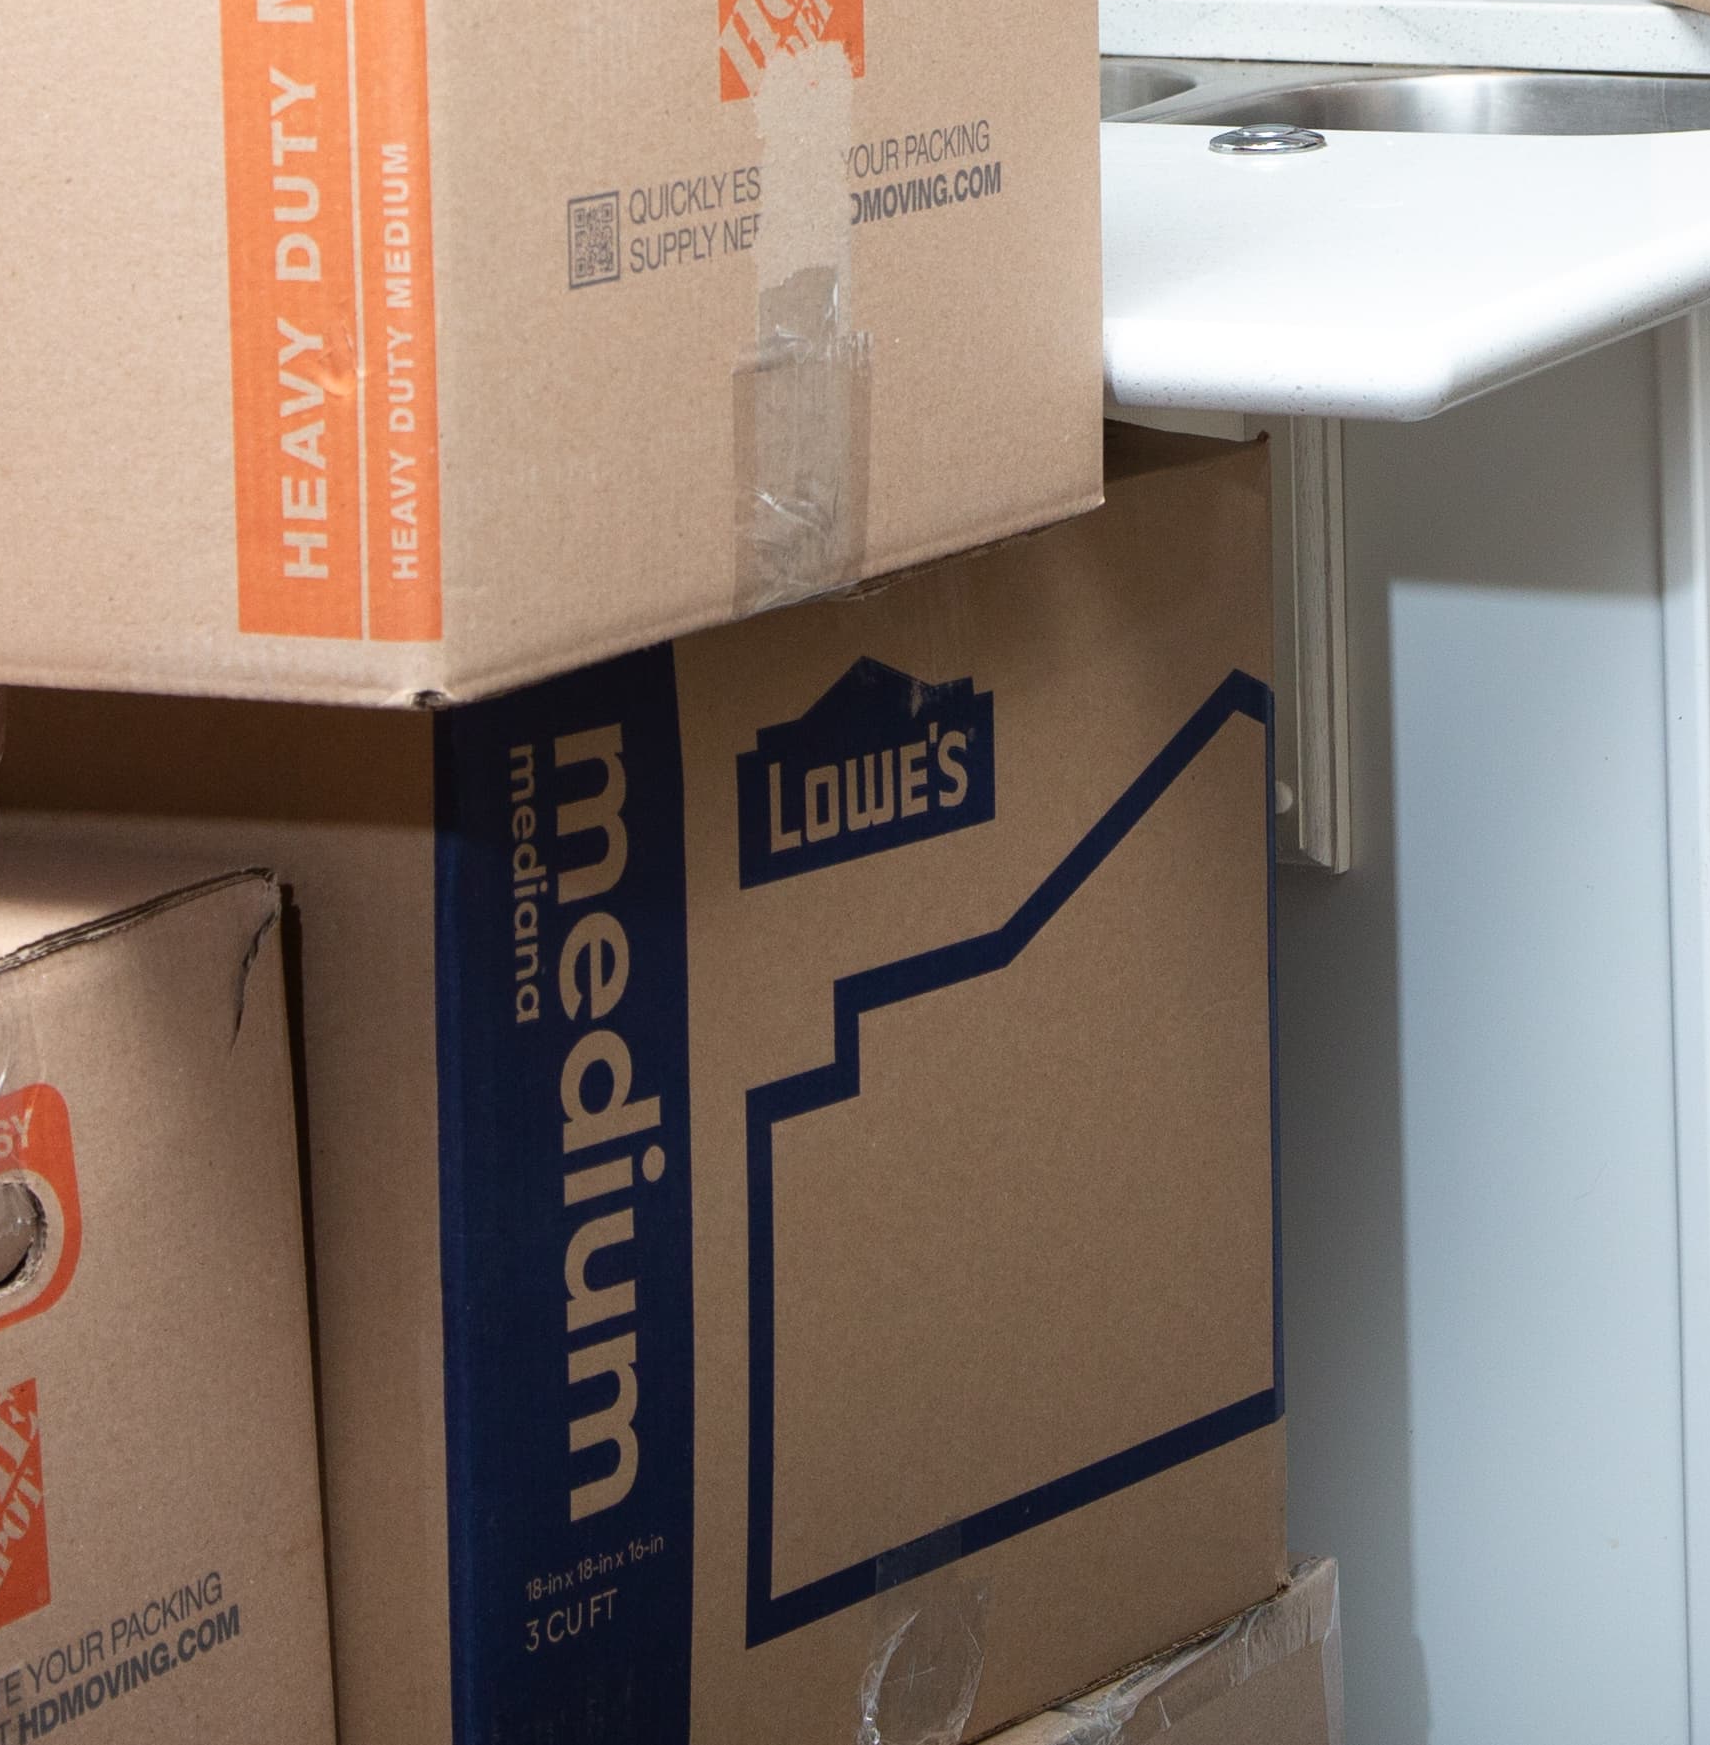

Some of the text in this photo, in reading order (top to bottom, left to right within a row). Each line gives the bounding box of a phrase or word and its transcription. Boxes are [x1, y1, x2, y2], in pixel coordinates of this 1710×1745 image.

[268, 67, 323, 282] DUTY
[629, 171, 728, 224] QUICKLY
[905, 120, 990, 169] PACKING
[629, 225, 718, 273] SUPPLY
[381, 143, 418, 580] HEAVY DUTY MEDIUM
[276, 316, 330, 580] HEAVY
[769, 722, 968, 853] LOWE'S
[512, 742, 551, 1026] mediana
[553, 722, 665, 1524] medium
[26, 1630, 106, 1695] YOUR
[111, 1571, 223, 1656] PACKING
[526, 1534, 664, 1601] 18-in x 18-in x 16-in
[526, 1588, 618, 1651] 3 CU FT
[17, 1604, 241, 1742] HDMOVING.COM
